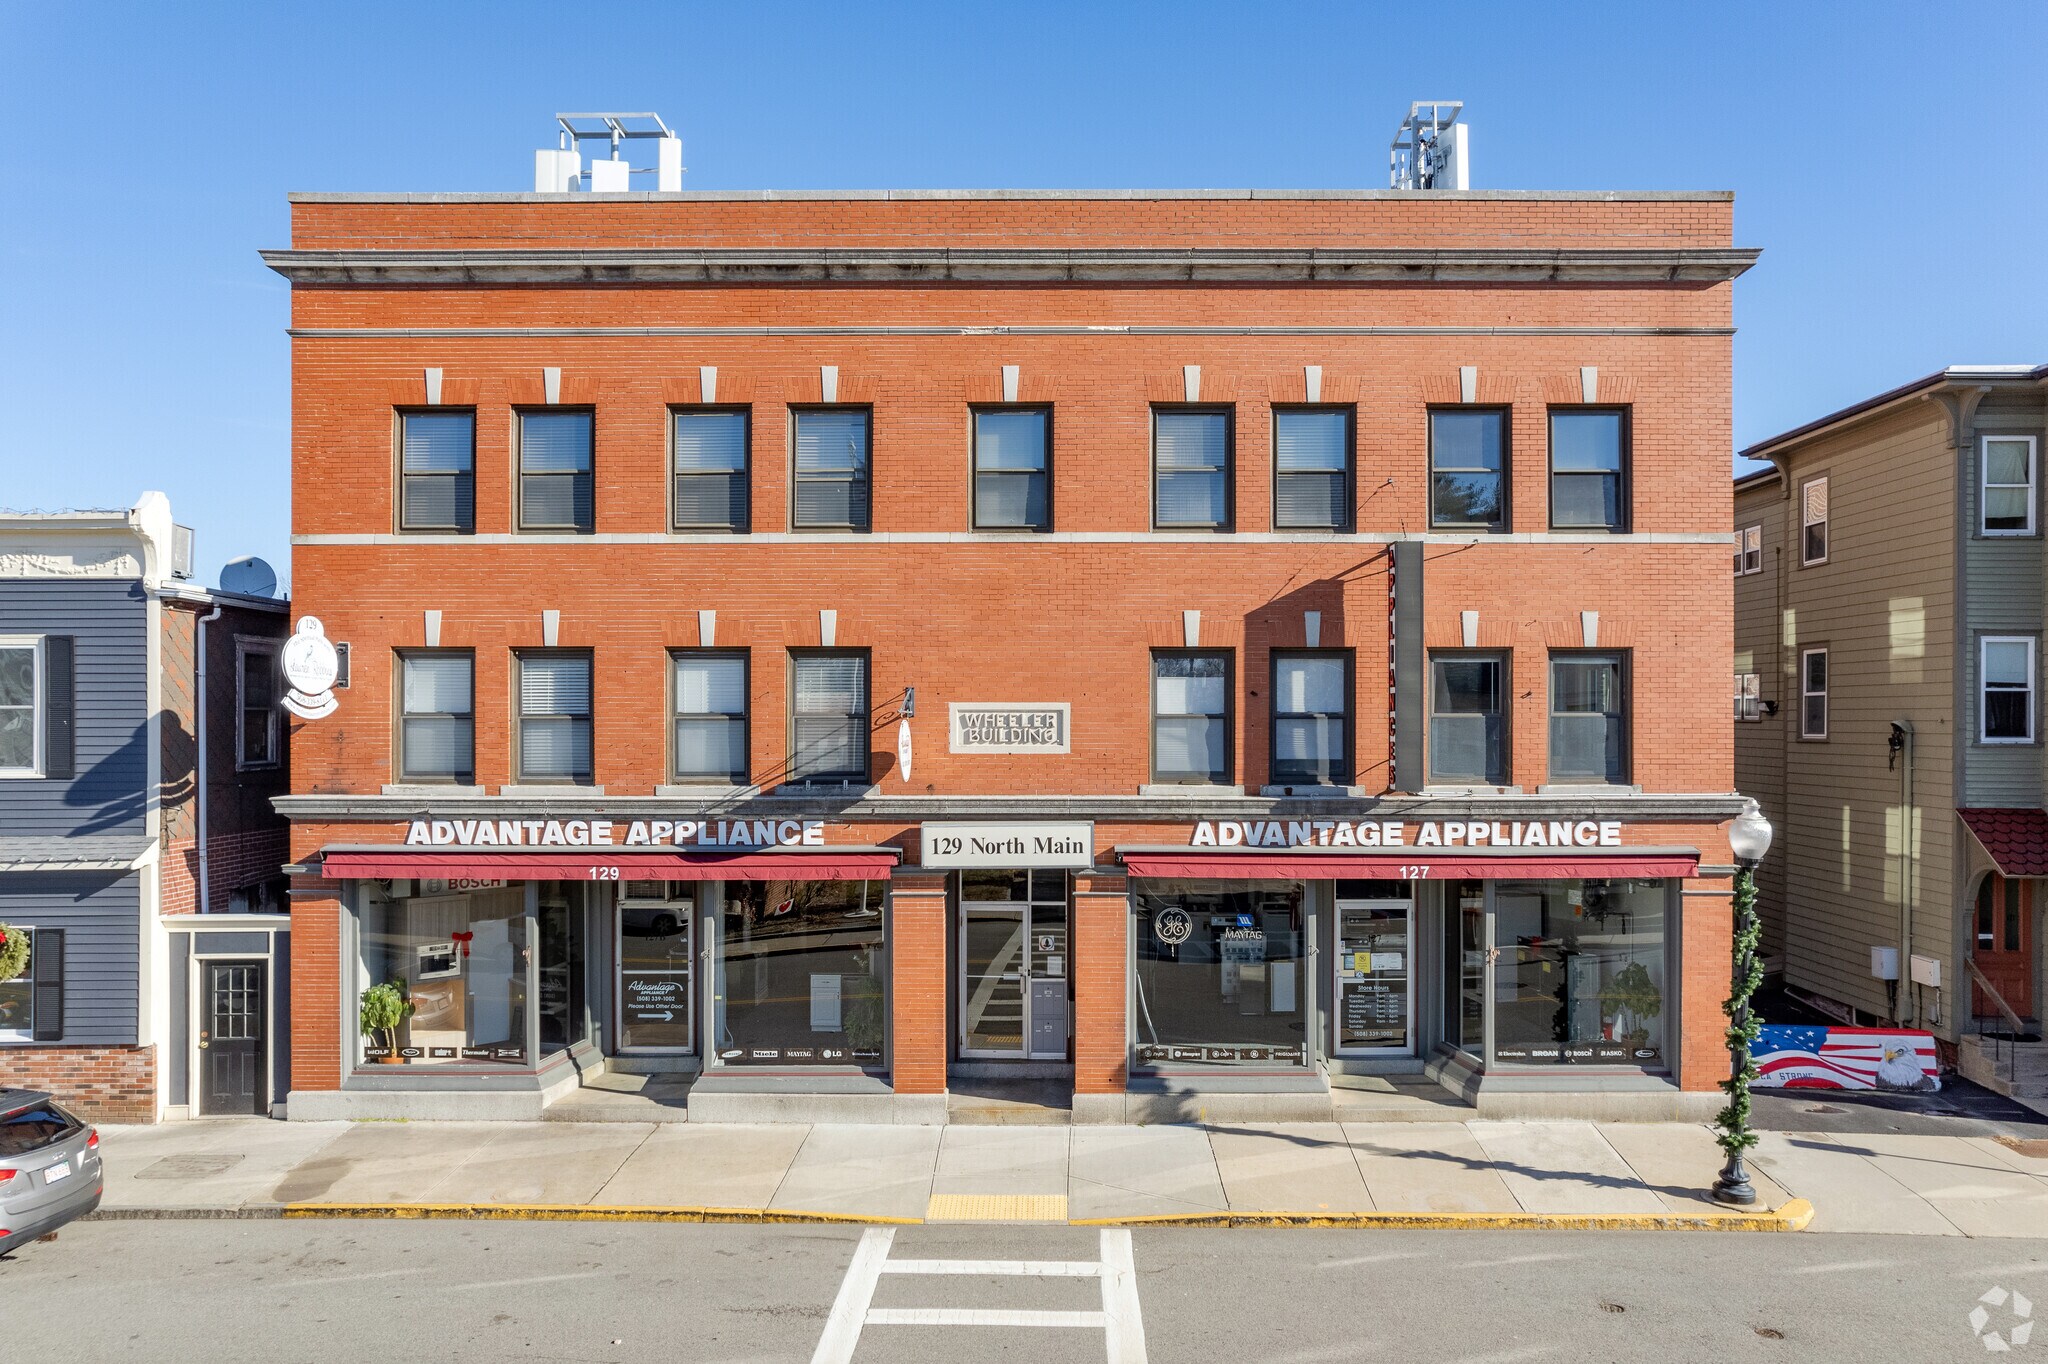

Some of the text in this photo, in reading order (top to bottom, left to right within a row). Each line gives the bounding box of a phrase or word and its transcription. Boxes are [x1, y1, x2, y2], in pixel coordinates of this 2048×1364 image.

[306, 619, 317, 630] 129
[966, 713, 1054, 727] WHEELER
[406, 820, 825, 845] ADVANTAGE APPLIANCE
[1192, 821, 1622, 846] ADVANTAGE APPLIANCE
[932, 836, 1084, 855] 129 North Main
[589, 867, 620, 880] 129
[1399, 866, 1430, 879] 127
[448, 878, 501, 890] BOSCH
[1225, 930, 1263, 940] MAYTAG
[1368, 934, 1381, 942] 127
[628, 980, 677, 994] Advantage
